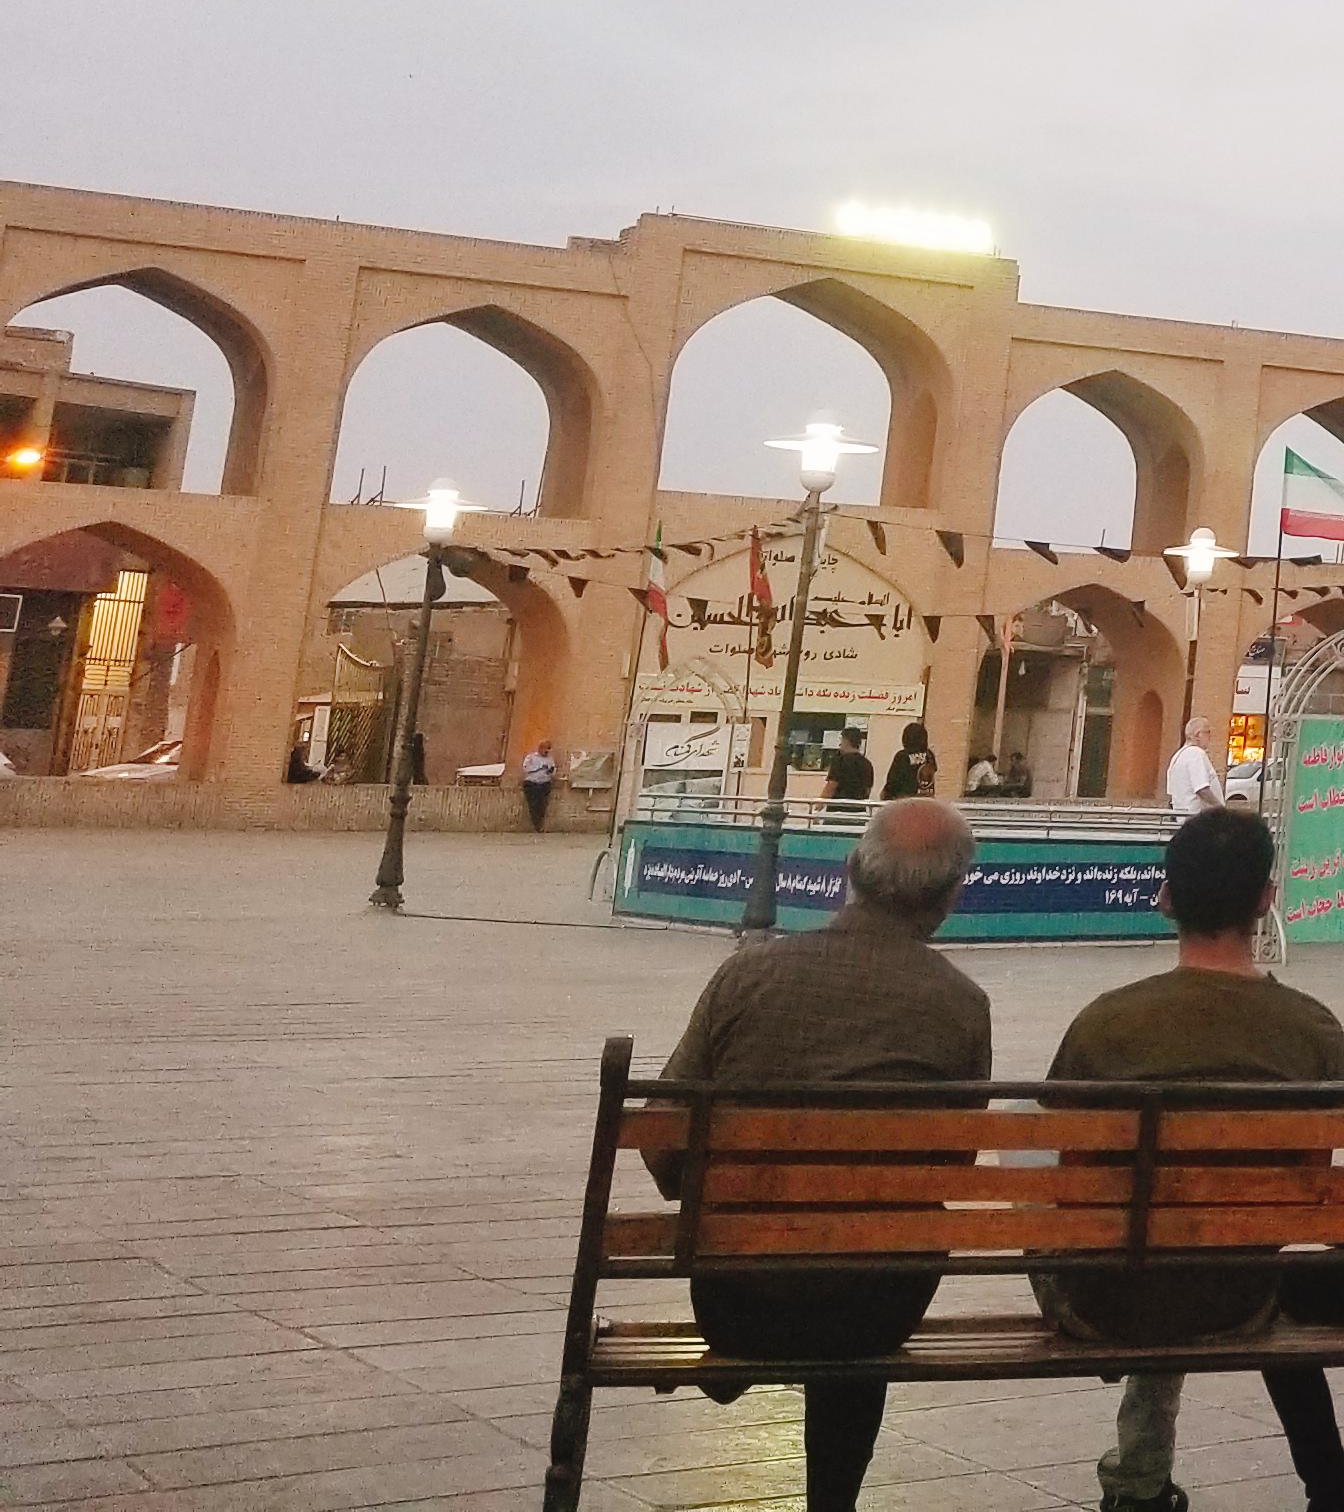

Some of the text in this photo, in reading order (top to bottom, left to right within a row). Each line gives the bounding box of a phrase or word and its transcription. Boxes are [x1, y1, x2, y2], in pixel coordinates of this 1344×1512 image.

[709, 643, 756, 657] صلوات
[823, 646, 858, 661] شادی
[1303, 744, 1328, 766] فاطمه
[1297, 789, 1318, 814] است
[962, 866, 984, 885] خور
[1001, 869, 1027, 885] روزی
[1026, 866, 1061, 884] خداوند
[1061, 866, 1076, 884] نزد
[1118, 866, 1138, 884] بلکه
[1124, 888, 1139, 905] آیه
[1286, 898, 1306, 924] است
